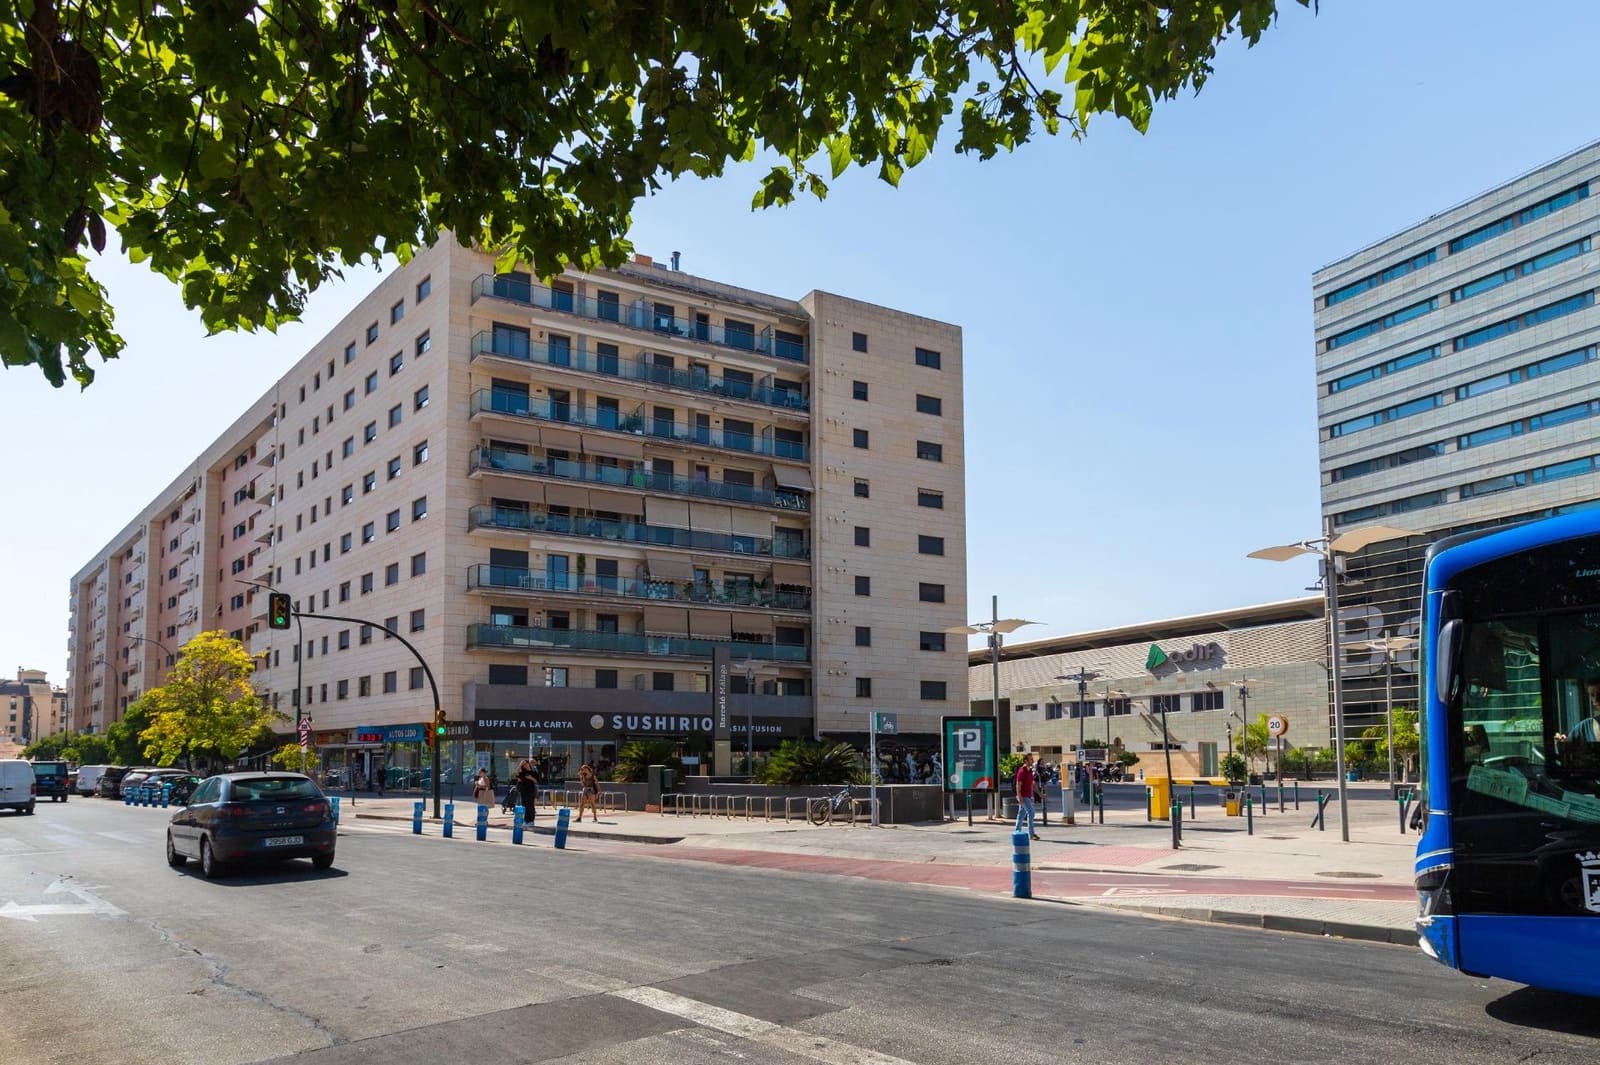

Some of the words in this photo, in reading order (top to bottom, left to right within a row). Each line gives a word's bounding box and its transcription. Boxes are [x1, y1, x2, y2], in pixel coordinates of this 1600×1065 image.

[478, 719, 517, 727] BUFFET
[519, 720, 527, 728] A
[543, 721, 574, 729] CARTA
[612, 715, 714, 731] SUSHIRIO
[1270, 721, 1280, 729] 20
[963, 732, 977, 749] P
[1078, 750, 1085, 759] P
